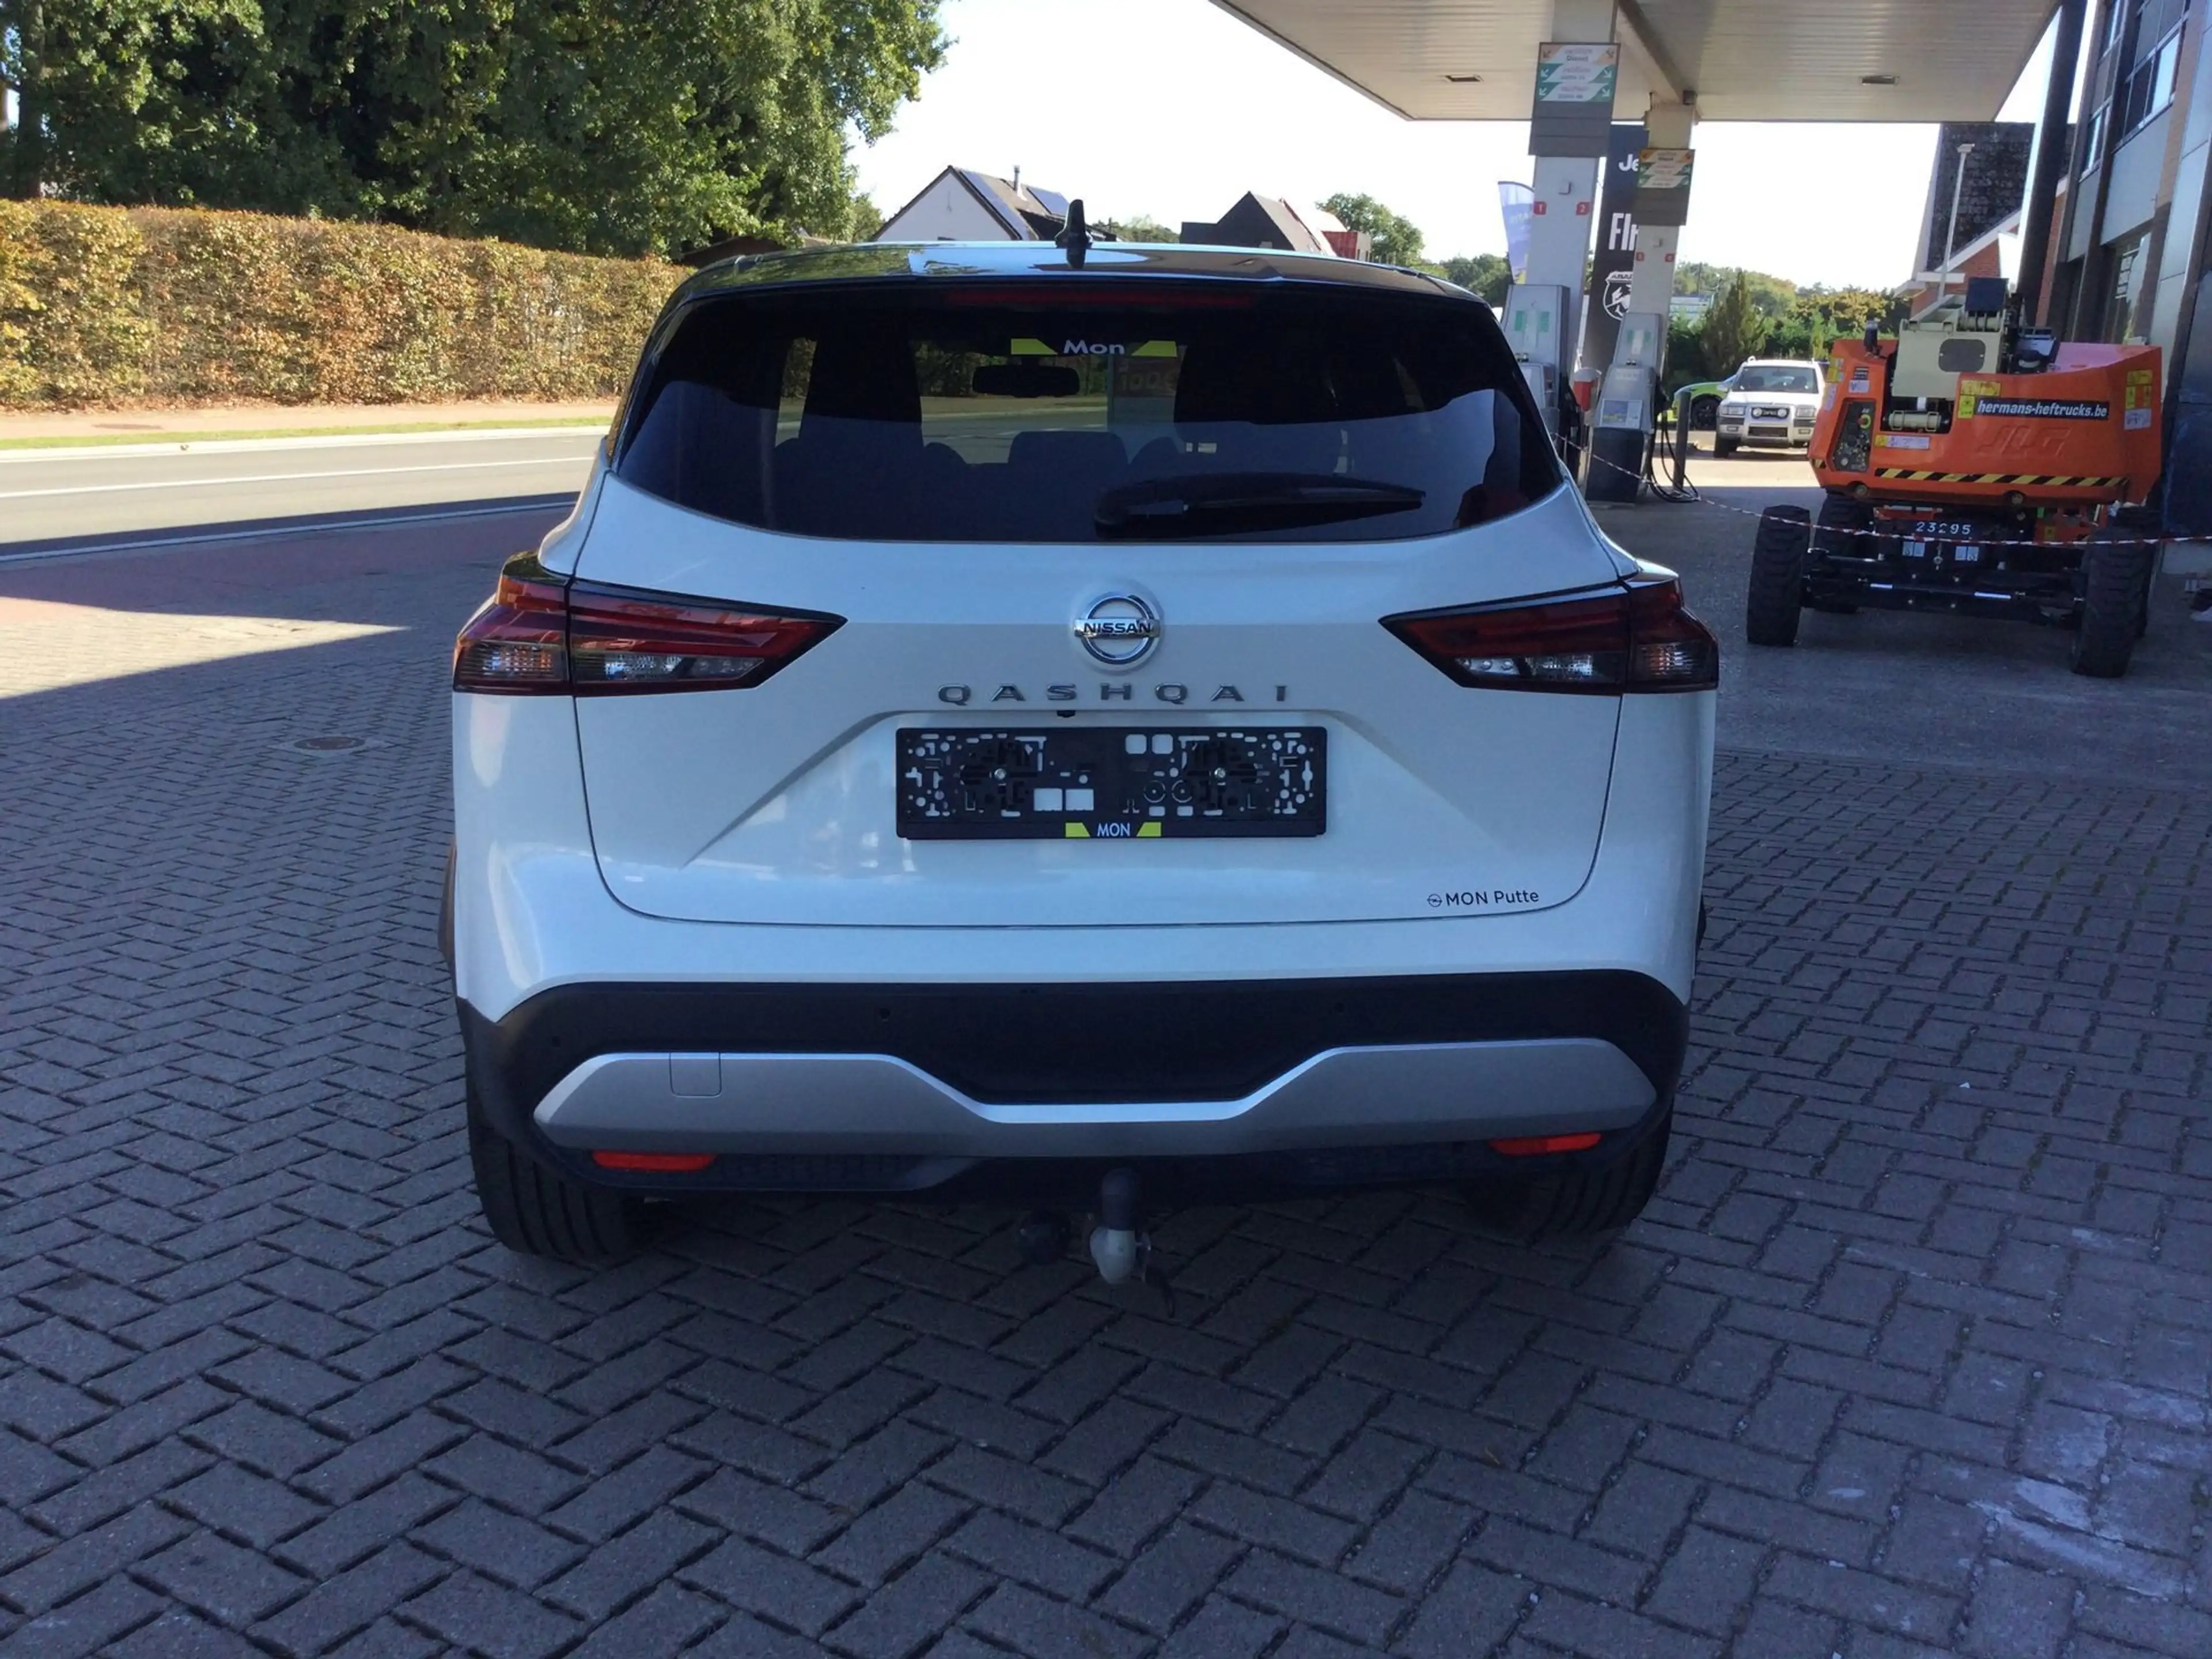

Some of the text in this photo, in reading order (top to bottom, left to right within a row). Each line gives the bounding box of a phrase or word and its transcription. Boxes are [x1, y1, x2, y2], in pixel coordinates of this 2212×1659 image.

[1063, 340, 1125, 354] Mon
[1977, 399, 2107, 418] hermans-heftrucks.be
[1916, 521, 1972, 535] 23295
[1084, 621, 1152, 634] NISSAN
[938, 683, 1288, 706] QASHQAI
[1096, 822, 1131, 838] MON
[1446, 889, 1539, 907] MON Putte
